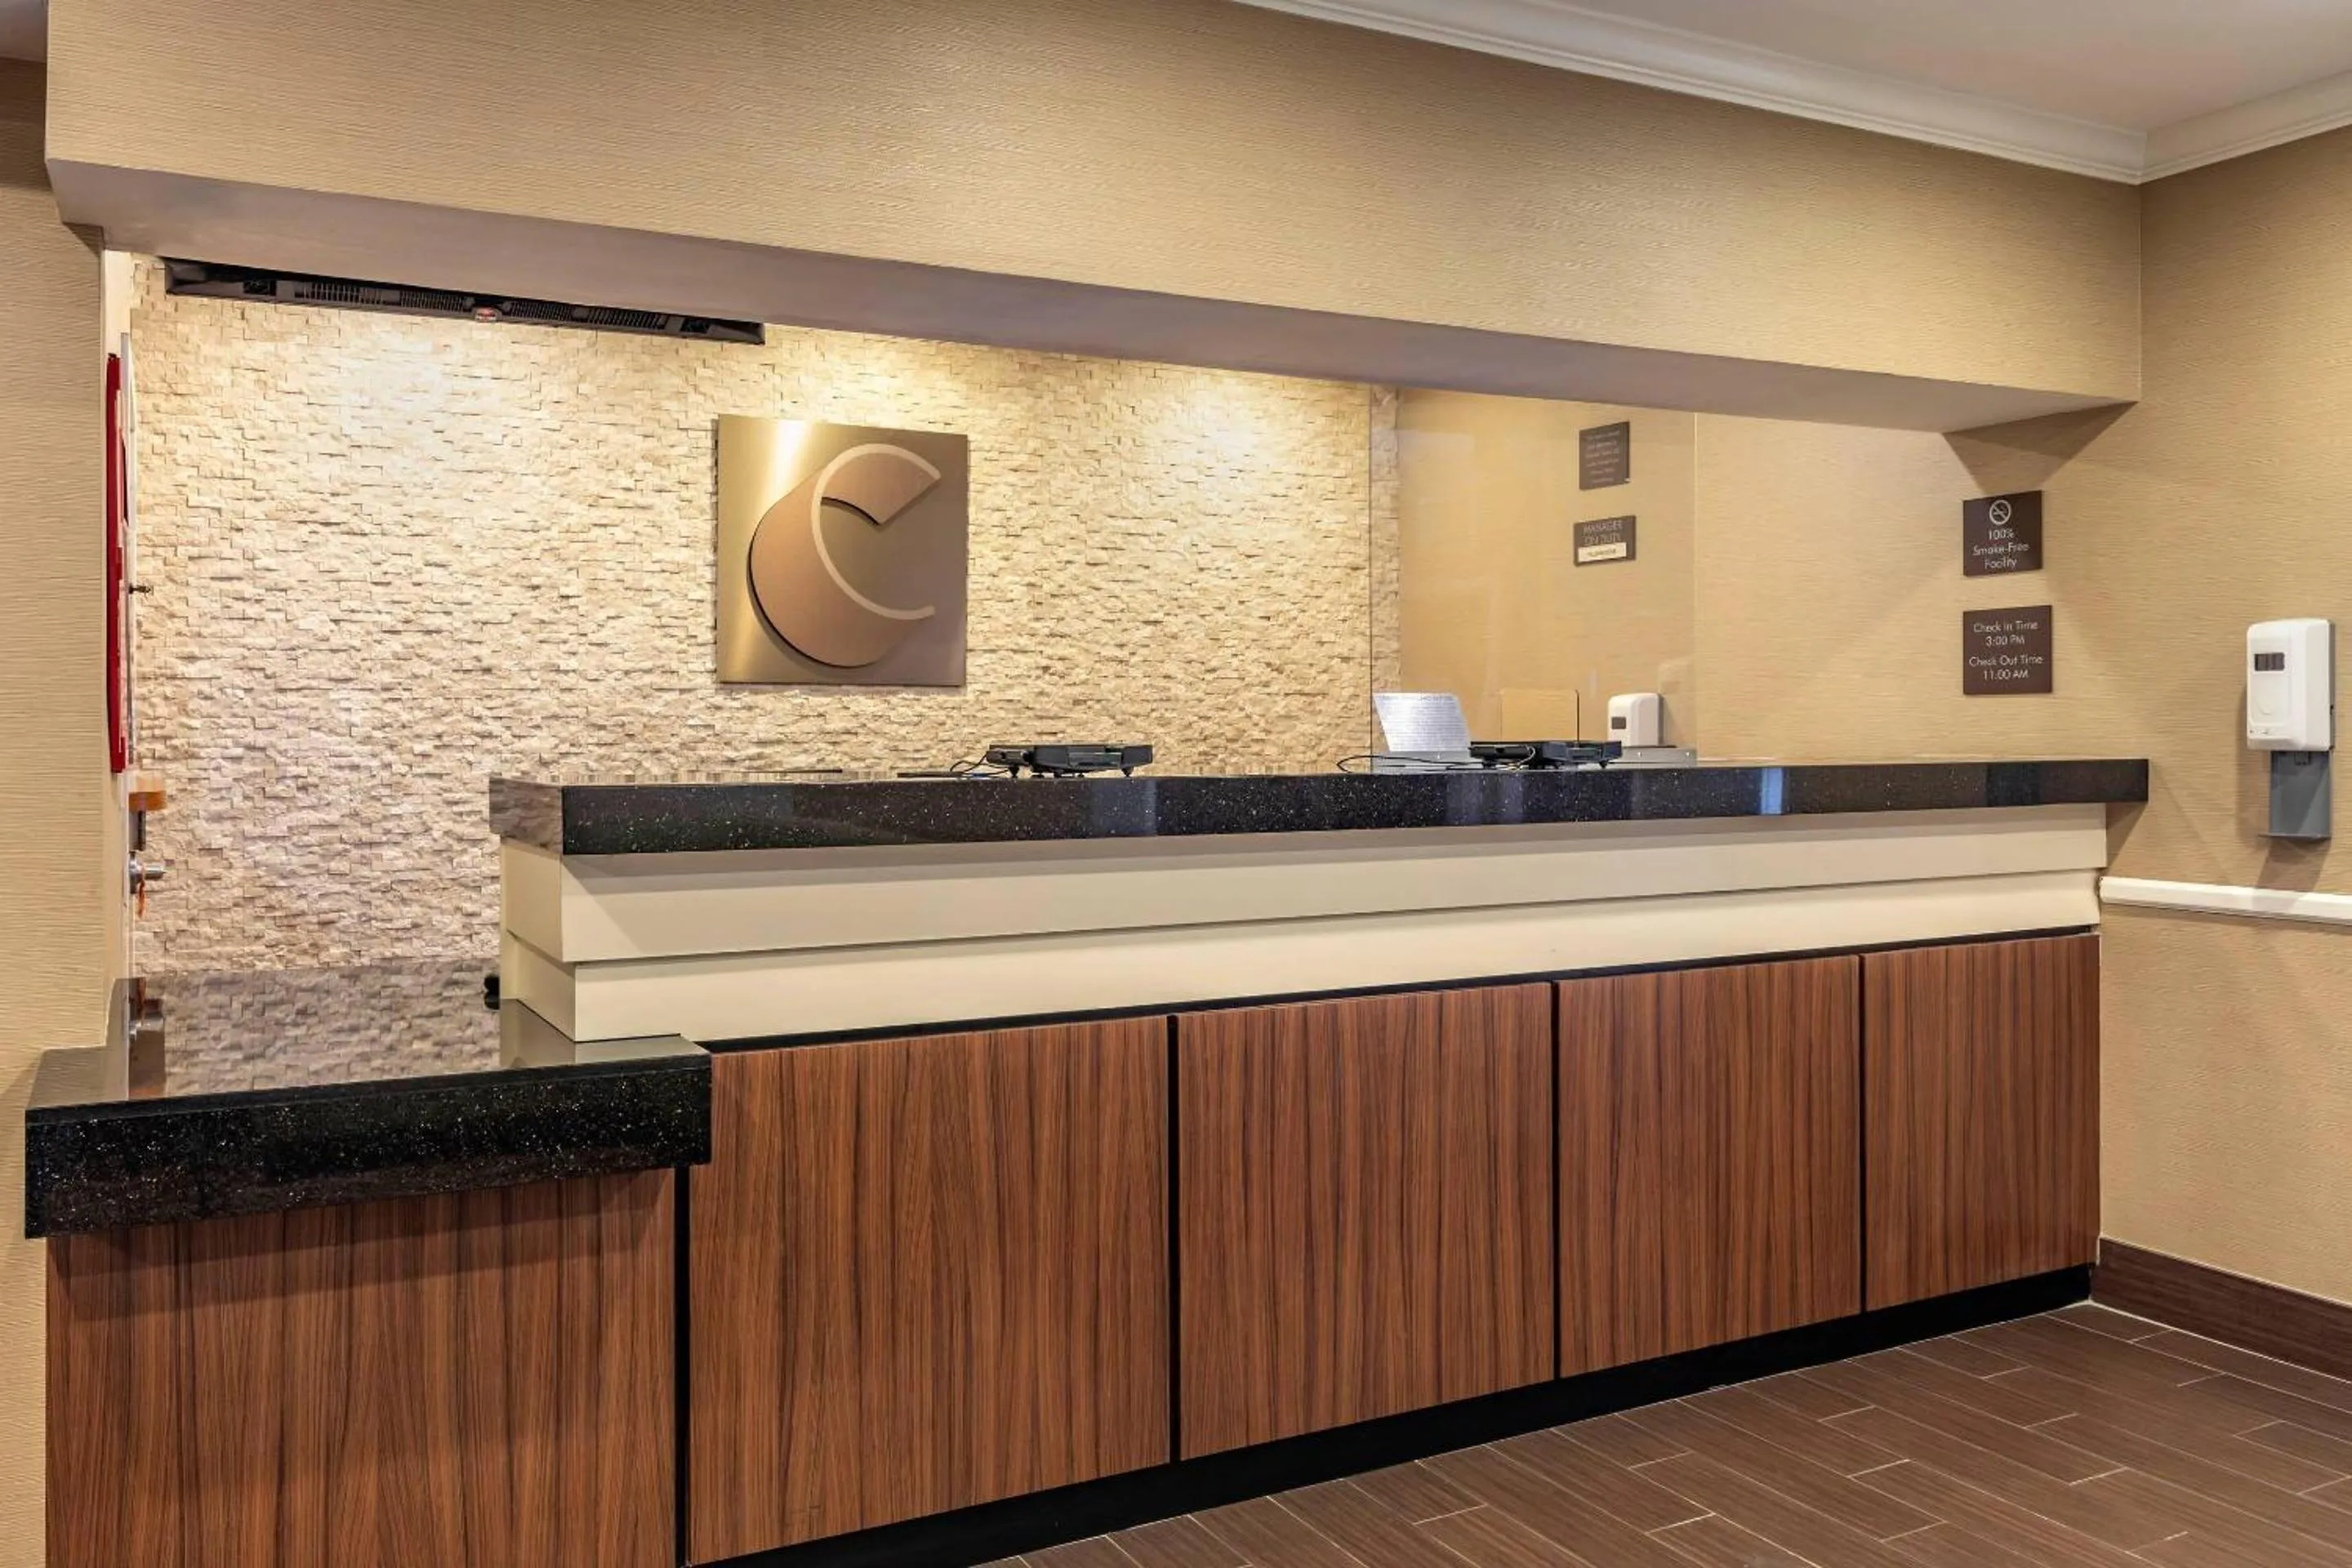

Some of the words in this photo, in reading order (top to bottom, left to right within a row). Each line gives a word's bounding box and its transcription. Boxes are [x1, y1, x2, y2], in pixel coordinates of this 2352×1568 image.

[1989, 528, 2015, 540] 100%
[1973, 541, 2030, 556] Smoke-Free
[1984, 555, 2017, 569] Facility
[1973, 621, 2002, 633] Check
[2015, 620, 2038, 630] Time
[1985, 635, 2008, 648] 3:00
[2010, 634, 2025, 645] PM
[1969, 656, 1998, 667] Check
[1999, 654, 2018, 666] Out
[2020, 654, 2044, 665] Time
[1983, 668, 2011, 680] 11:00
[2012, 669, 2029, 679] AM
